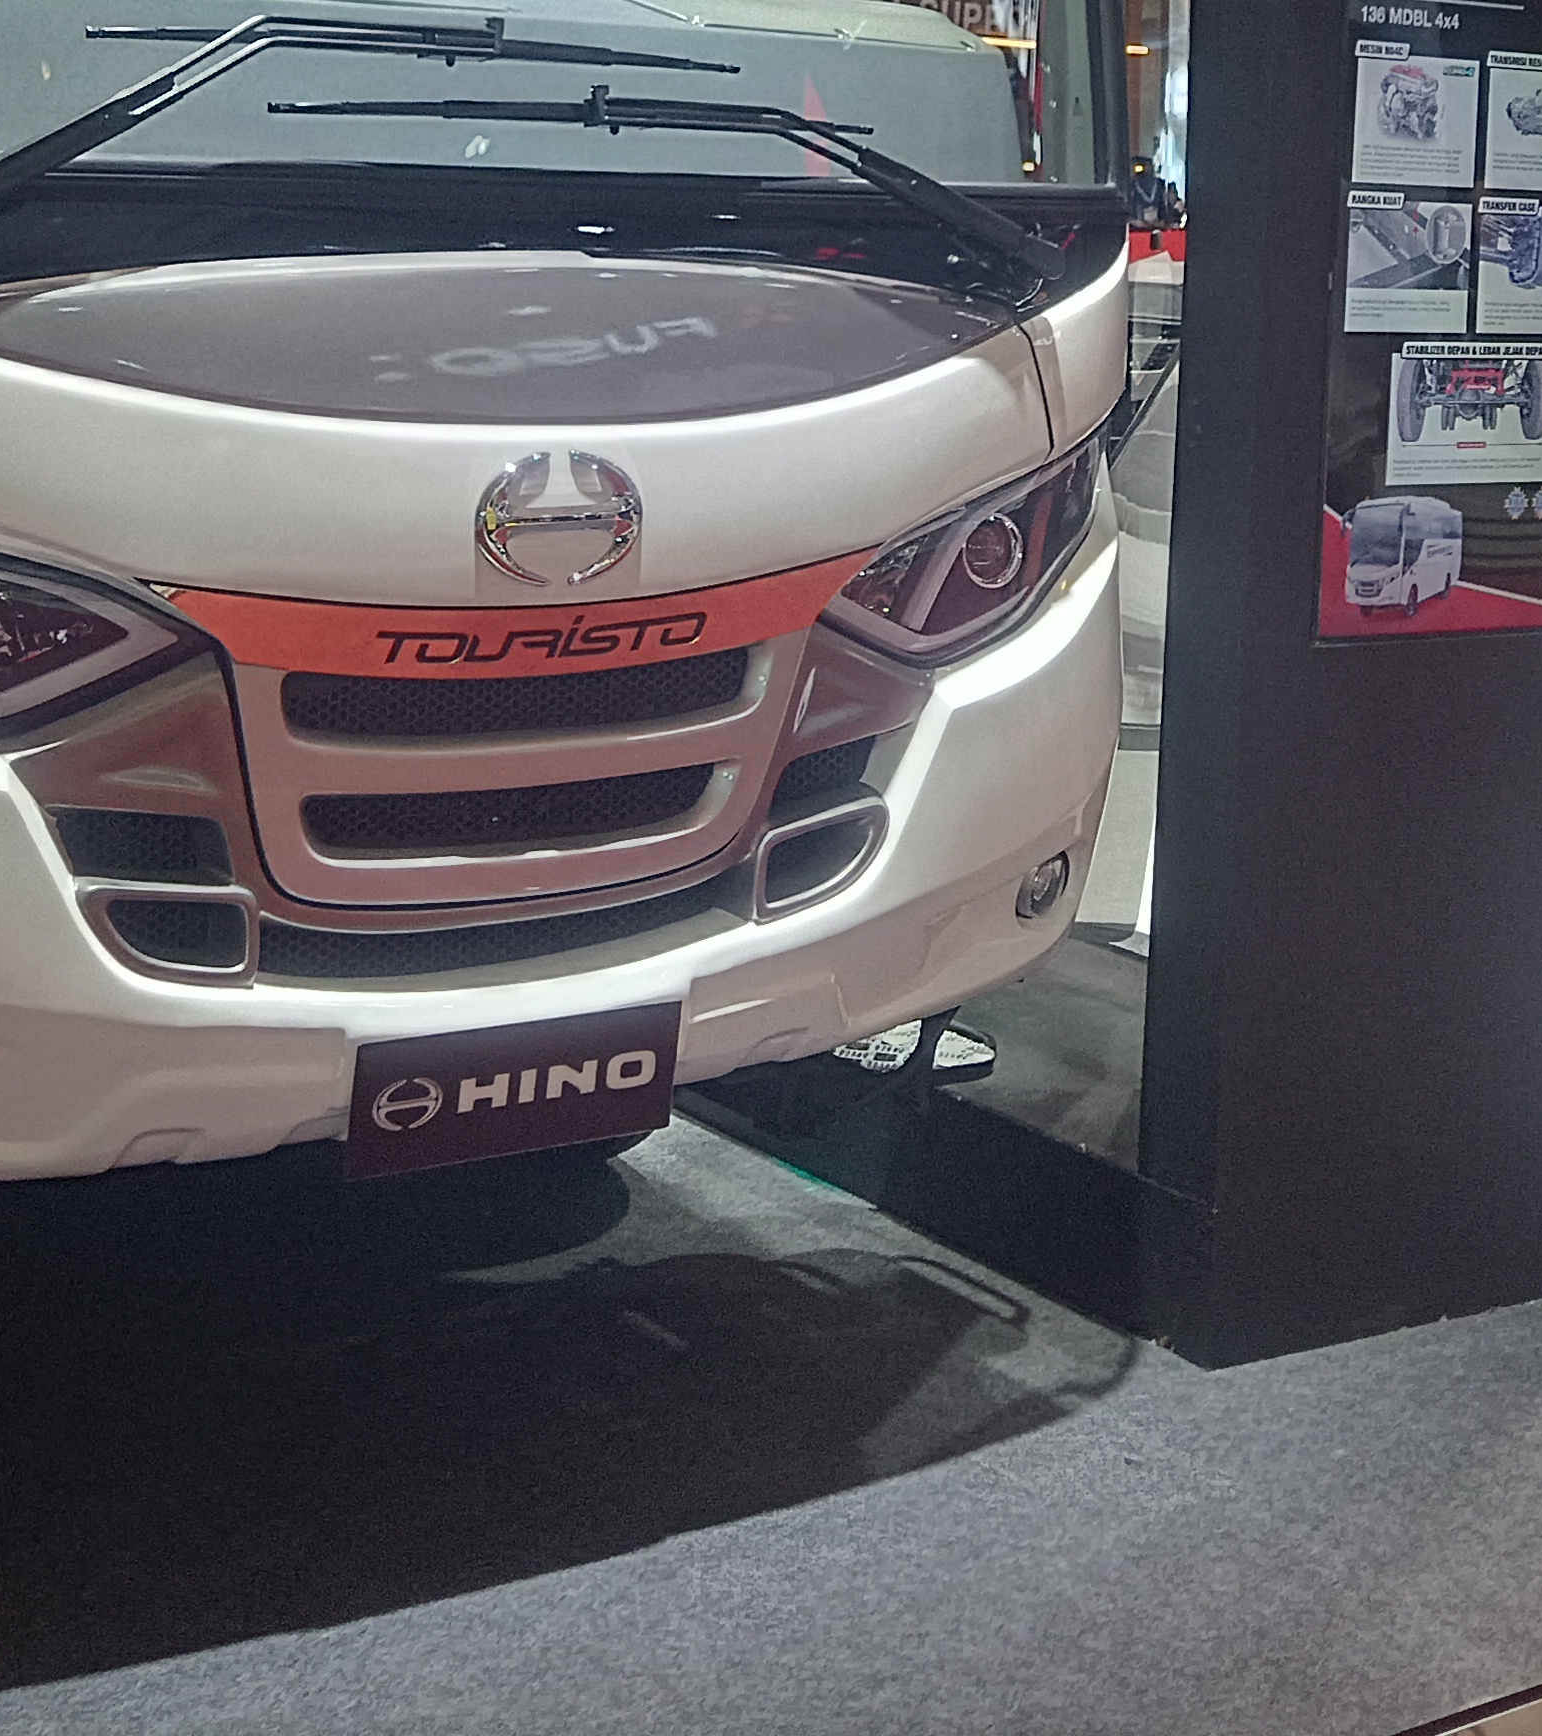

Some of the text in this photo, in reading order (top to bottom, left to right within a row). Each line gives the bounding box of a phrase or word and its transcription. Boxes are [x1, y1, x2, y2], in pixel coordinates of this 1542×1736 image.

[1361, 5, 1460, 31] 136 MDBL 4x4
[1481, 199, 1536, 212] TRANSFER CASE
[456, 1048, 658, 1115] HINO
